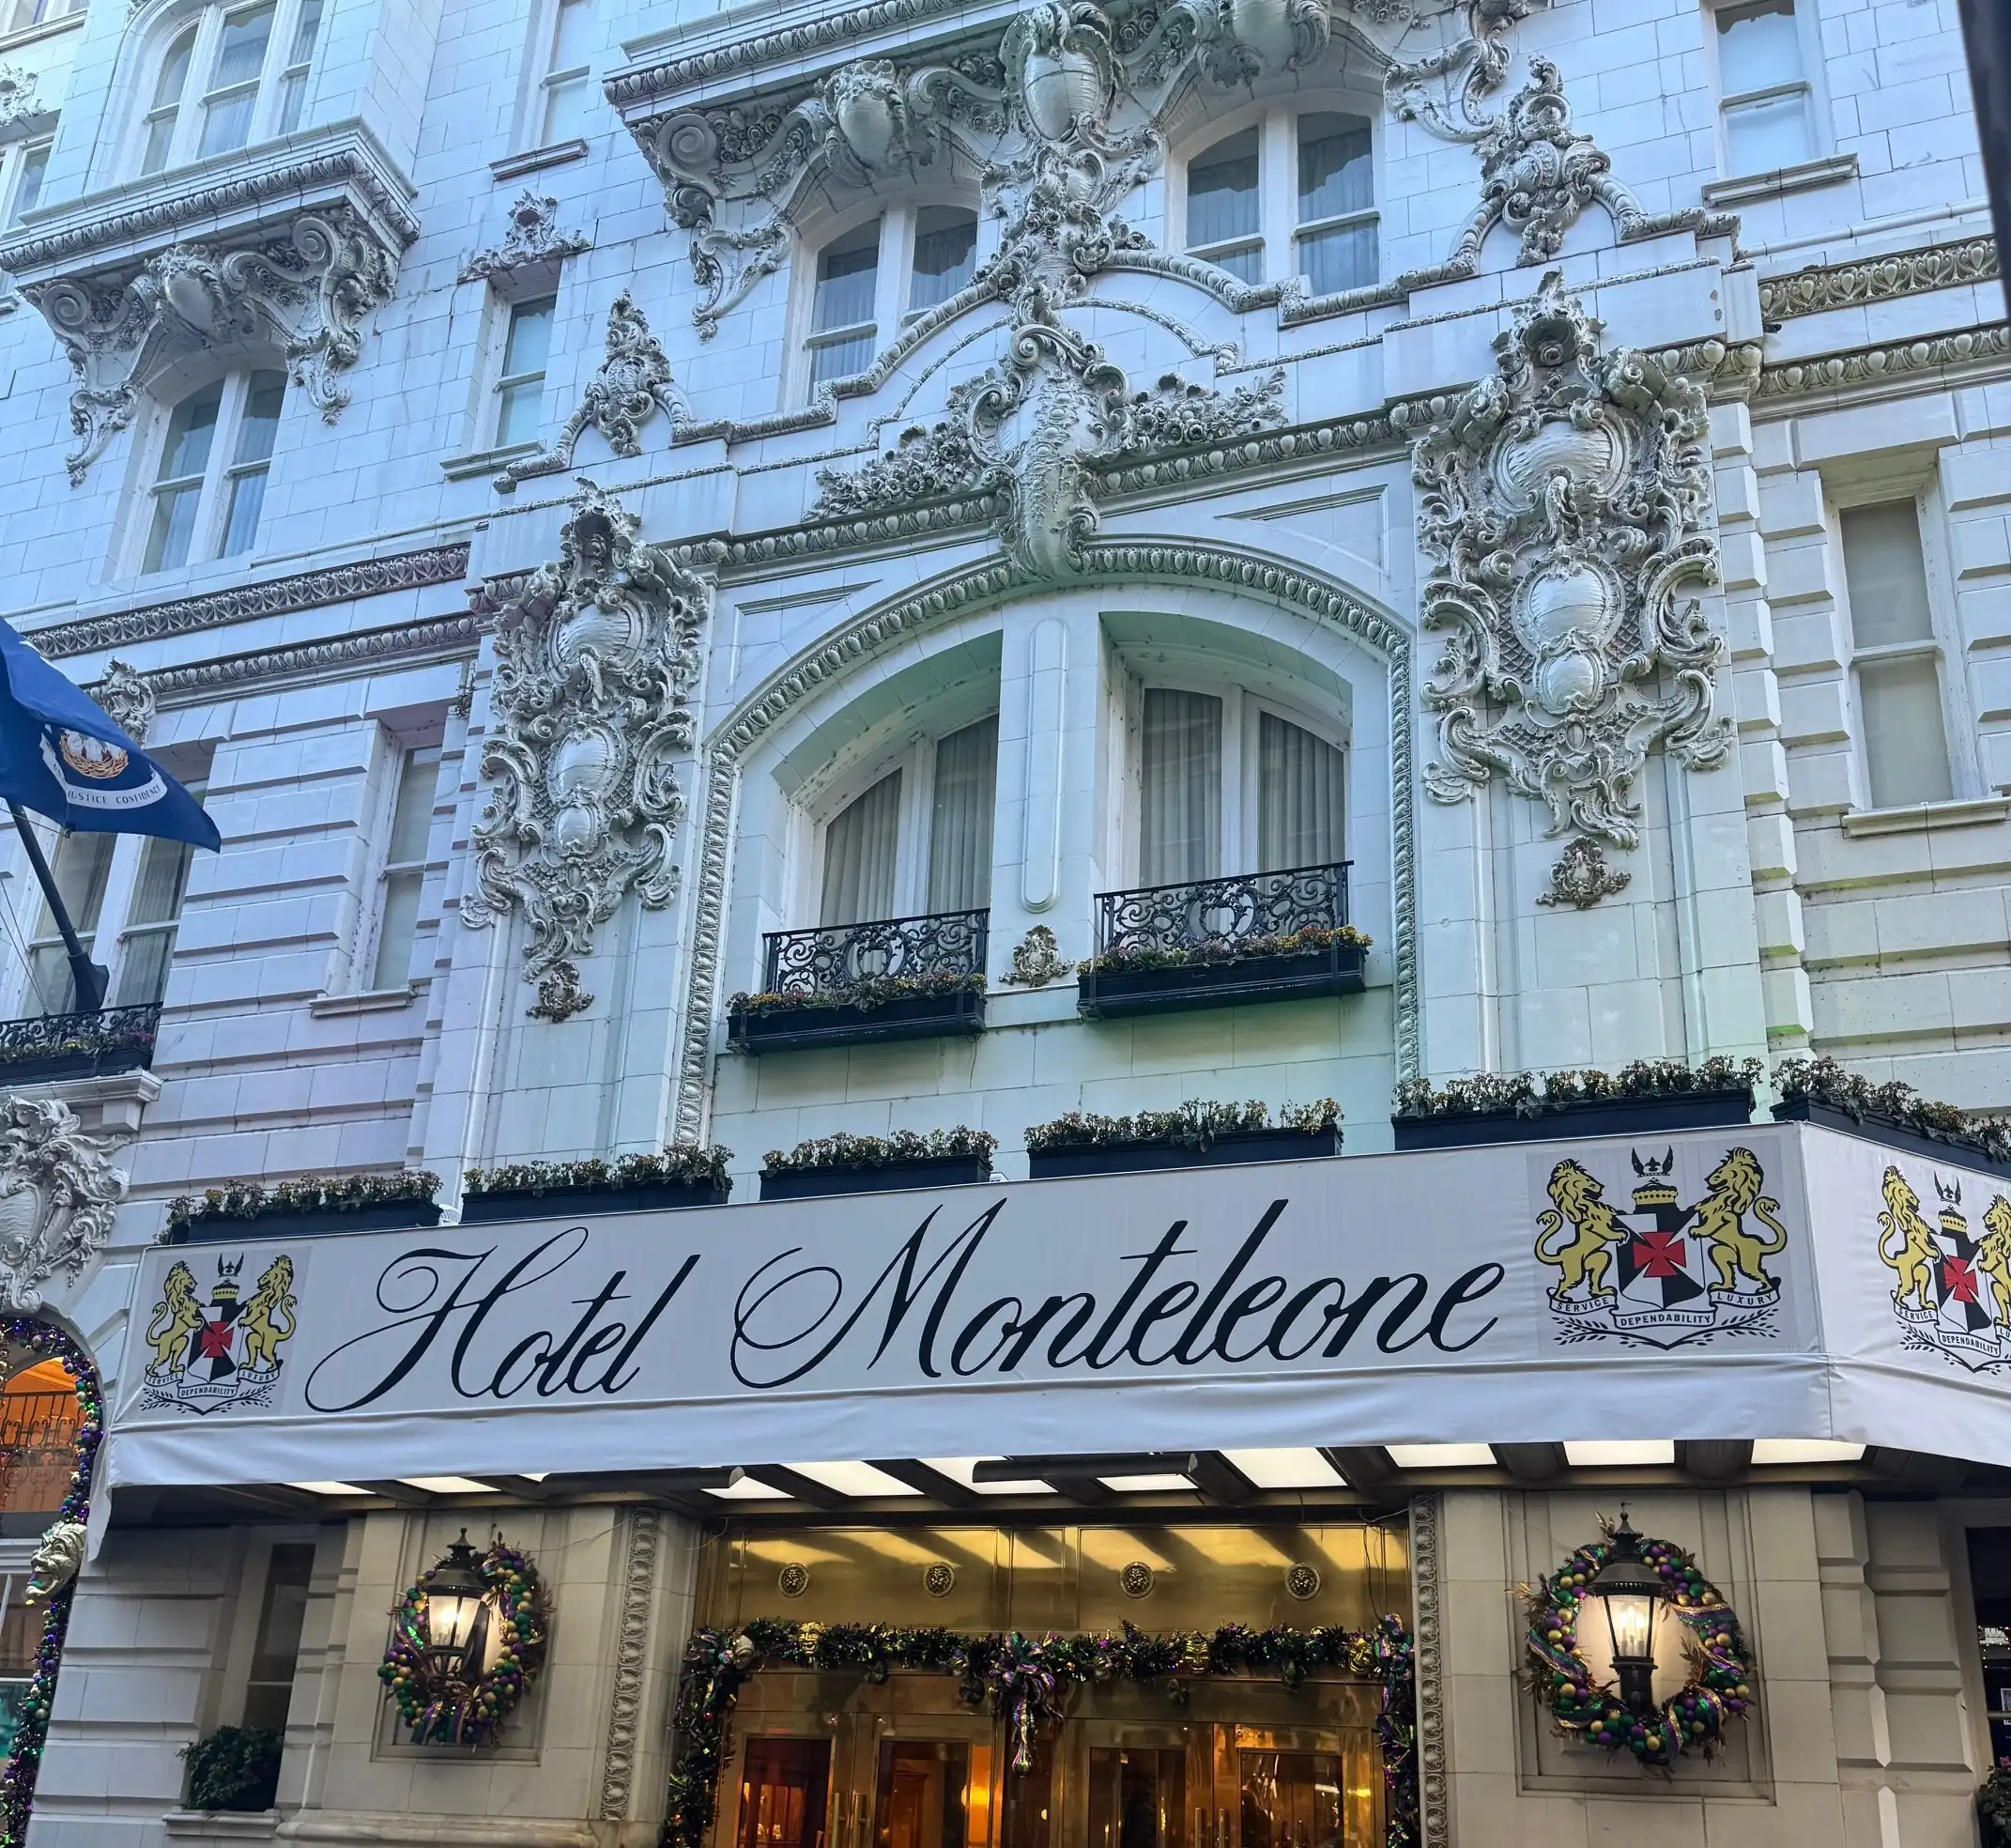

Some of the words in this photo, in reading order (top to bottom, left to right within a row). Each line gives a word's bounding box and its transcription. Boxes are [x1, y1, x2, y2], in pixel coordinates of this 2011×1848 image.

[304, 1225, 701, 1413] Hotel
[729, 1197, 1506, 1390] Monteleone
[1556, 1297, 1610, 1312] SERVICE
[1716, 1292, 1773, 1305] LUXURY
[1898, 1306, 1934, 1320] SERVICE
[1620, 1315, 1712, 1327] DEPENDABILITY
[1942, 1334, 1999, 1355] DEPENDABILITY
[147, 1373, 179, 1384] SERVICE
[241, 1371, 276, 1381] LUXURY
[180, 1388, 236, 1397] DEPENDABILITY
